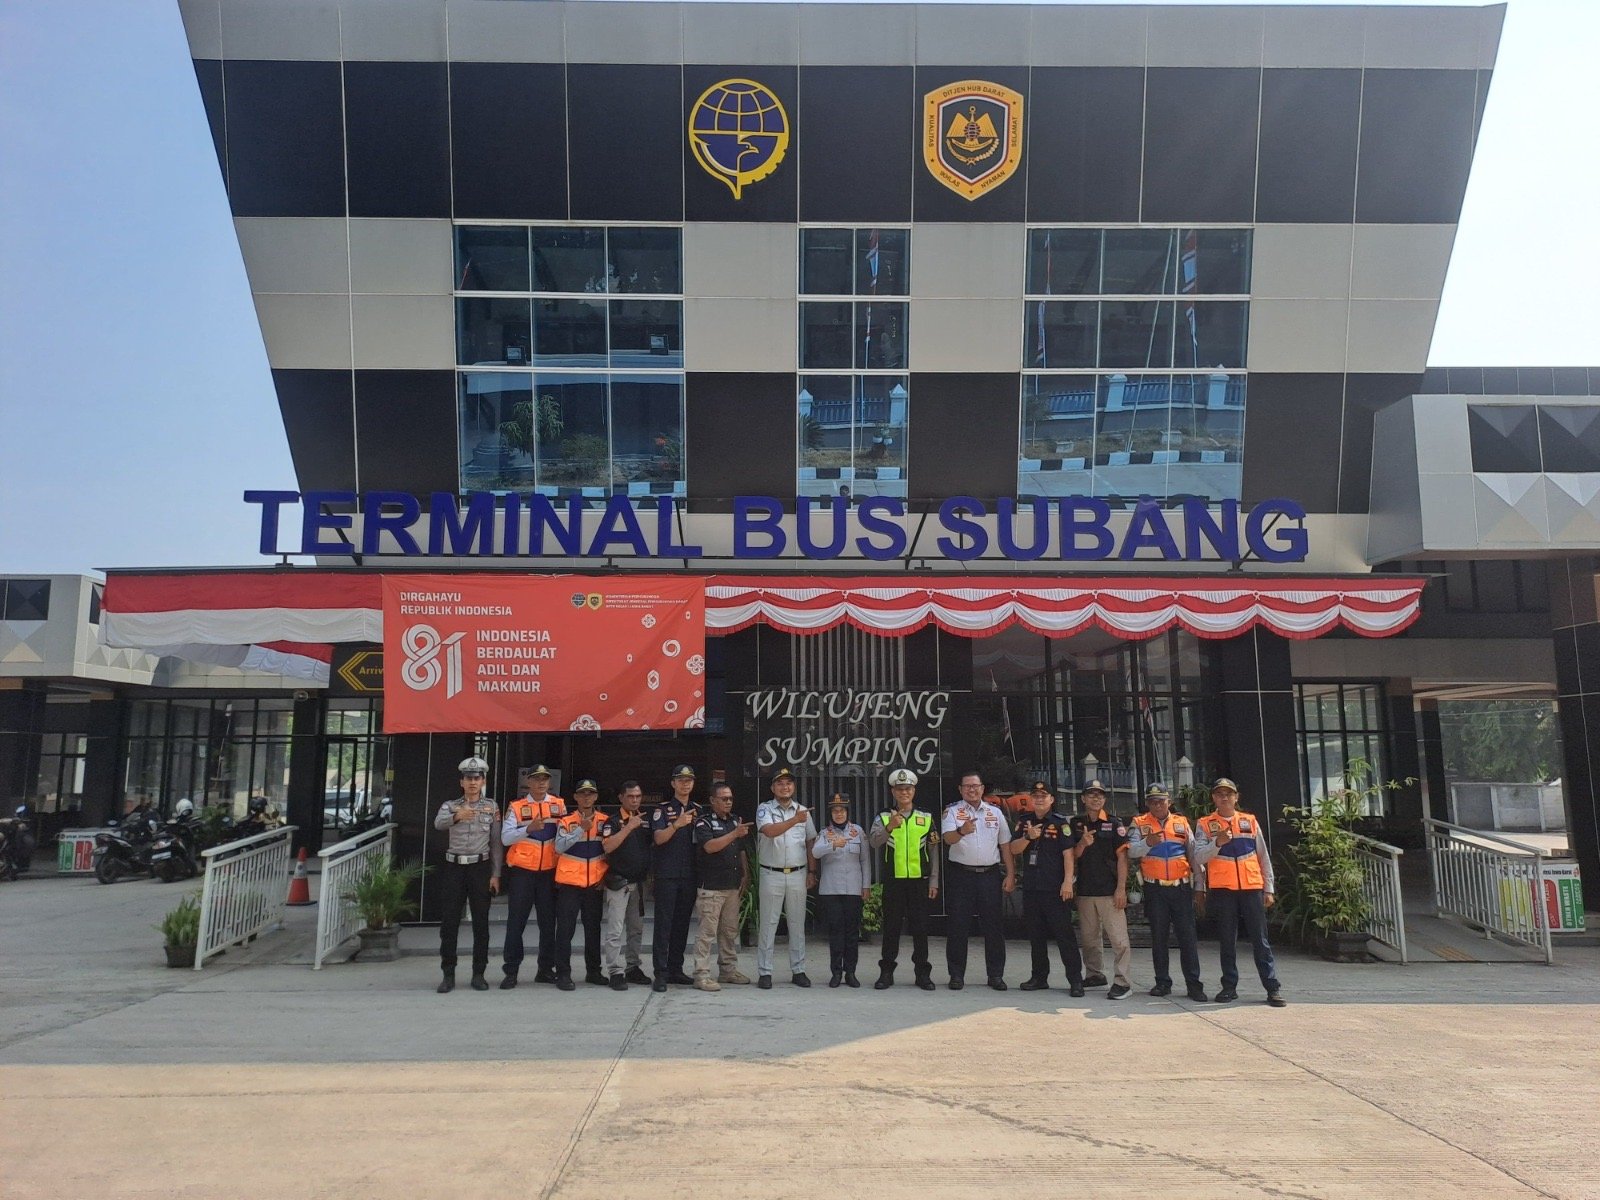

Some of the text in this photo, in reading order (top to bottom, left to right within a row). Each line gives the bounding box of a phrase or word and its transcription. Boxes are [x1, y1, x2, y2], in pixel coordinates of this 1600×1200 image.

[943, 87, 966, 98] DITJEN
[983, 87, 1005, 98] DARAT
[981, 171, 1005, 188] NYAMAN
[243, 490, 1309, 564] TERMINAL BUS SUBANG
[400, 591, 461, 603] DIRGAHAYU
[400, 604, 512, 616] REPUBLIK INDONESIA
[476, 629, 551, 642] INDONESIA
[476, 646, 557, 659] BERDAULAT
[401, 623, 468, 700] 81
[477, 663, 540, 676] ADIL DAN
[477, 680, 541, 693] MAKMUR
[746, 687, 949, 729] WILUJENG
[758, 733, 938, 775] SUMPING
